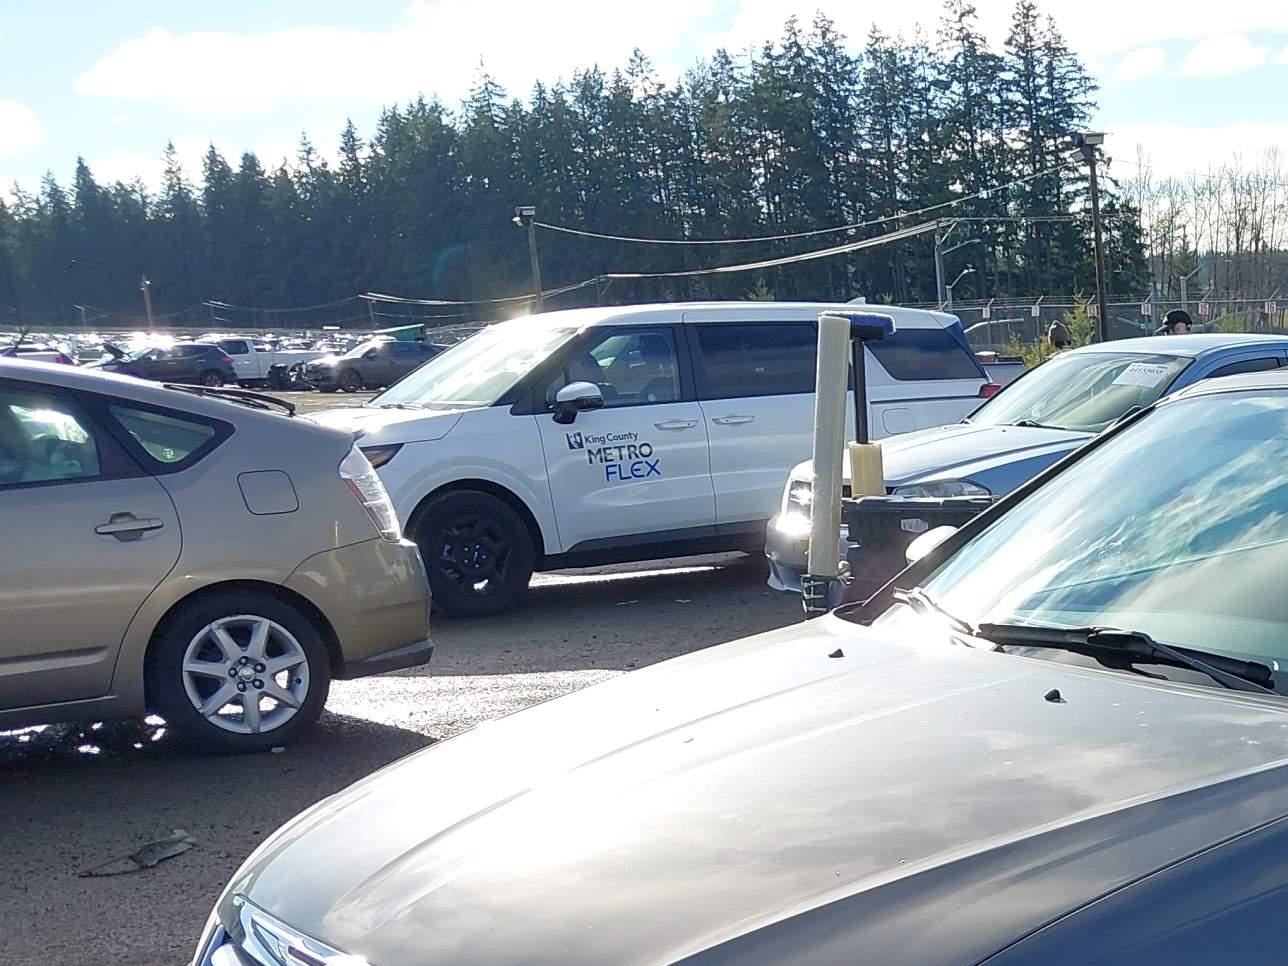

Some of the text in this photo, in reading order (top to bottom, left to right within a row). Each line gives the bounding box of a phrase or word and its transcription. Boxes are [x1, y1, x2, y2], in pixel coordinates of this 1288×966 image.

[584, 432, 638, 445] King County
[587, 443, 653, 464] METRO
[605, 459, 661, 482] FLEX
